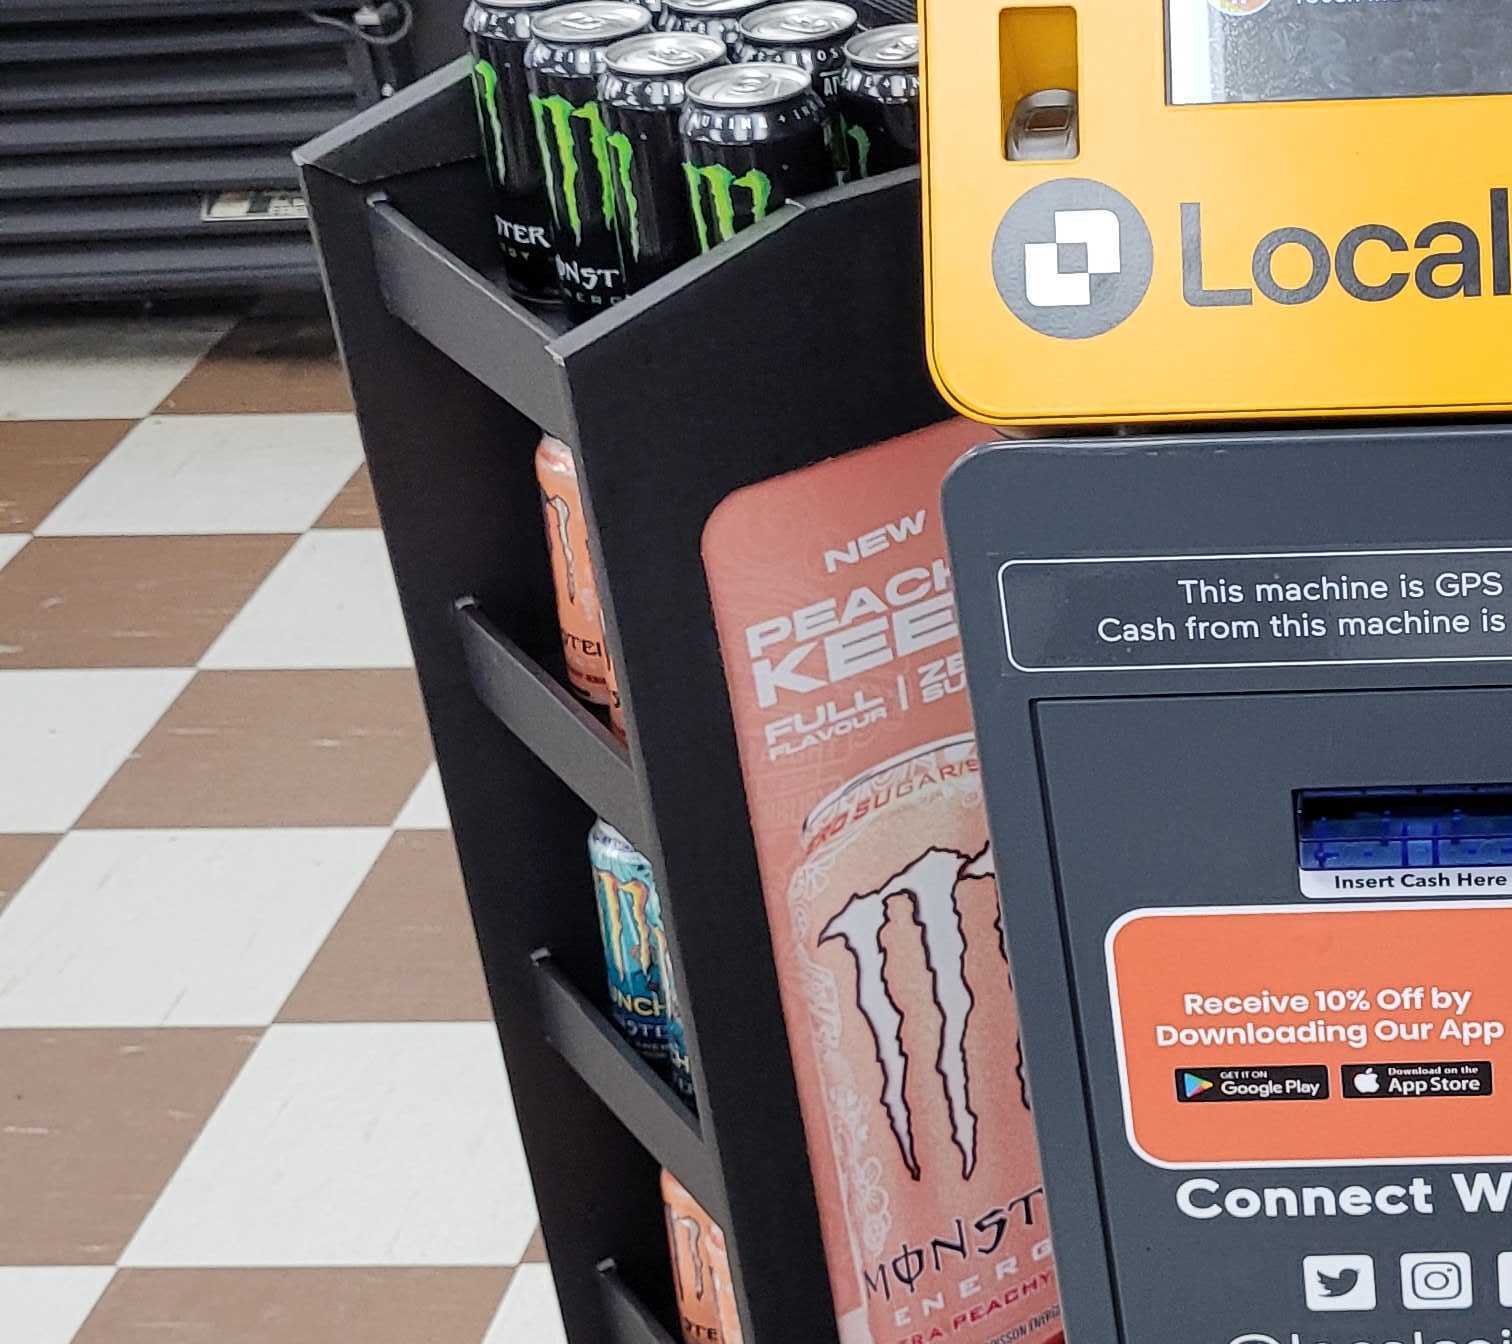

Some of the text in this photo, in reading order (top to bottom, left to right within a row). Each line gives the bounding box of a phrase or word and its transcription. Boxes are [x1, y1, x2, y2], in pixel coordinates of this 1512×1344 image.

[495, 214, 551, 248] TER
[824, 509, 926, 573] NEW
[1177, 576, 1244, 605] This
[1254, 574, 1390, 602] machine
[1399, 572, 1425, 598] is
[1435, 570, 1504, 598] GPS
[1096, 616, 1176, 643] Cash
[1184, 613, 1261, 641] from
[1269, 611, 1328, 638] this
[1337, 608, 1471, 636] machine
[1480, 606, 1508, 632] is
[764, 690, 885, 745] FULL
[768, 705, 887, 761] FLAVOUR
[1334, 872, 1508, 890] Insert Cash Here
[1184, 985, 1473, 1015] Receive 10% Off by
[1155, 1015, 1504, 1051] Downloading Our App
[1220, 1070, 1267, 1079] GET IT ON
[1388, 1064, 1479, 1076] Download on the
[1388, 1075, 1481, 1097] App Store
[1220, 1078, 1321, 1100] Google Play
[1175, 1175, 1433, 1219] Connect
